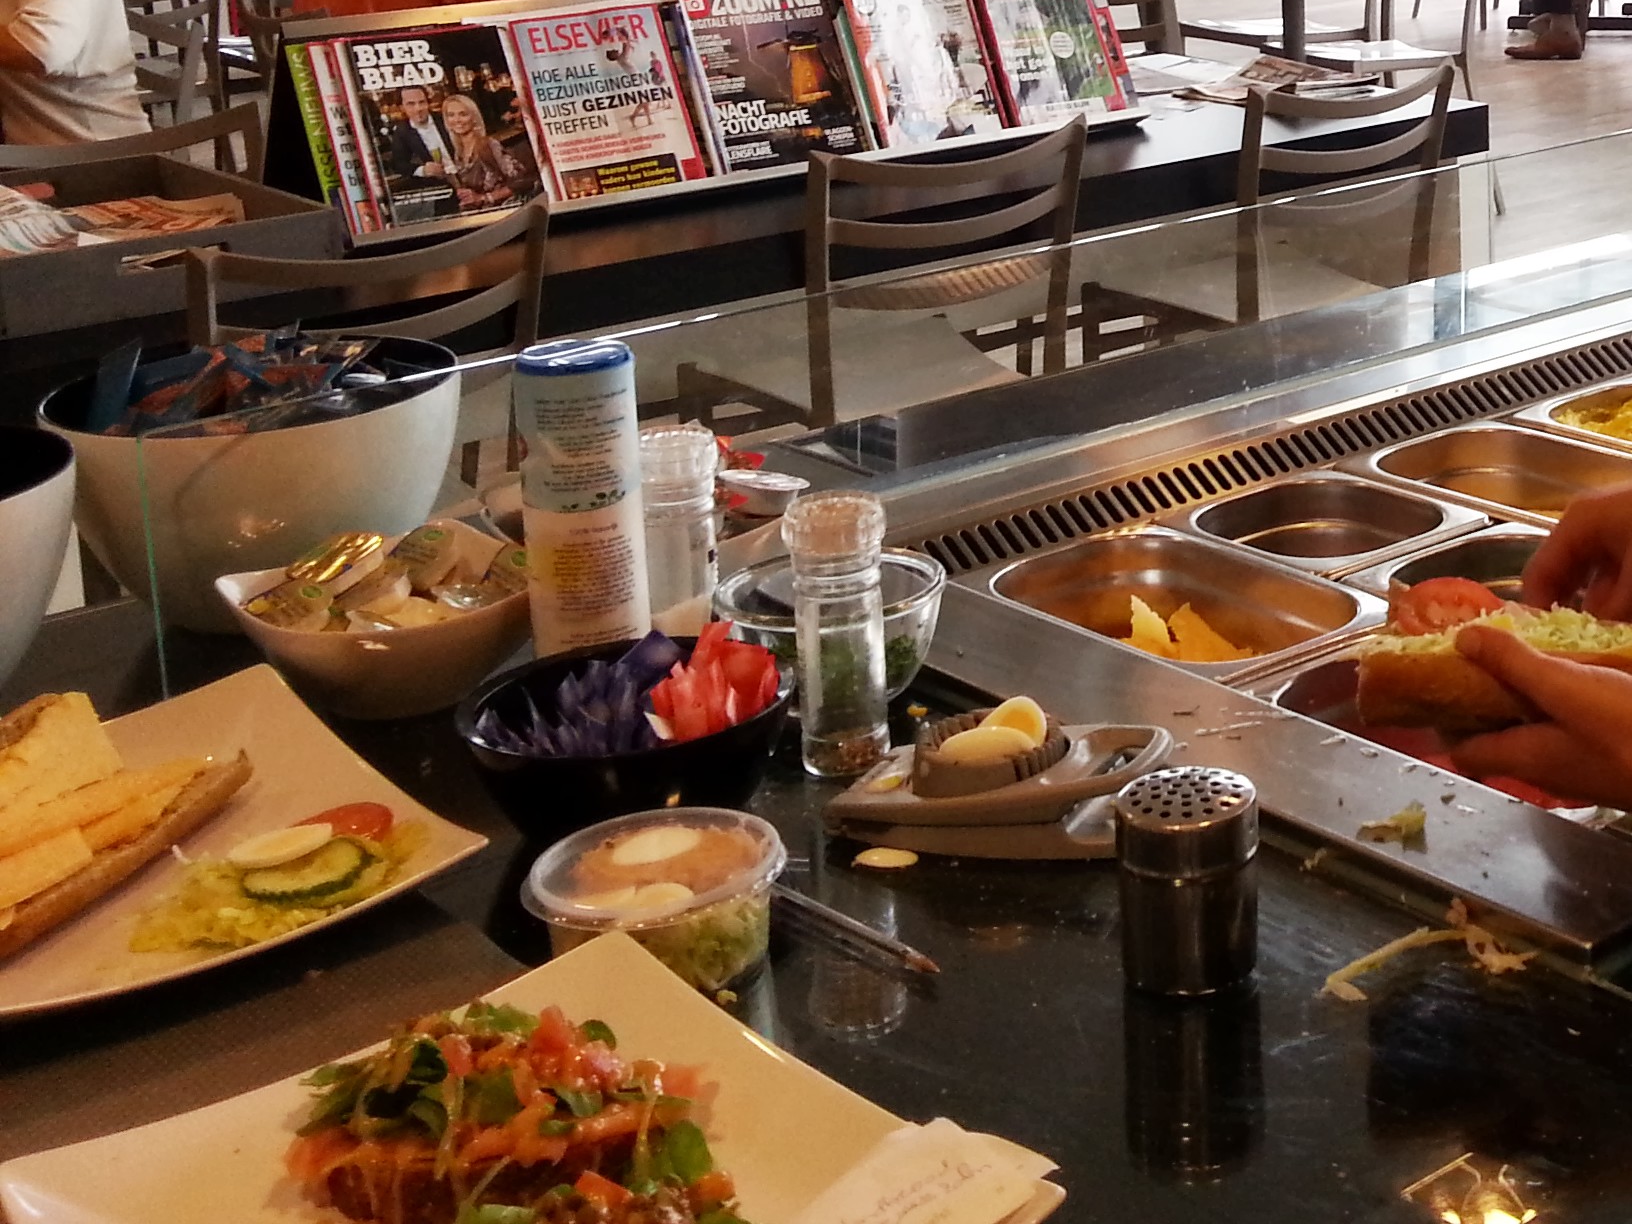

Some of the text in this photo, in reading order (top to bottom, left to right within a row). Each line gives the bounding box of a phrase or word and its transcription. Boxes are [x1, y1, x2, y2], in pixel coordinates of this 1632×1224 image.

[527, 14, 649, 54] ELSEVIER
[353, 40, 435, 68] BIER
[359, 62, 444, 90] BLAD
[531, 64, 599, 85] HOE ALLE
[535, 72, 650, 102] BEZUINIGINGEN
[541, 87, 674, 119] JUIST GEZINNEN
[715, 99, 766, 121] NACHT
[545, 115, 609, 136] TREFFEN
[719, 108, 812, 135] FOTOGRAFIE
